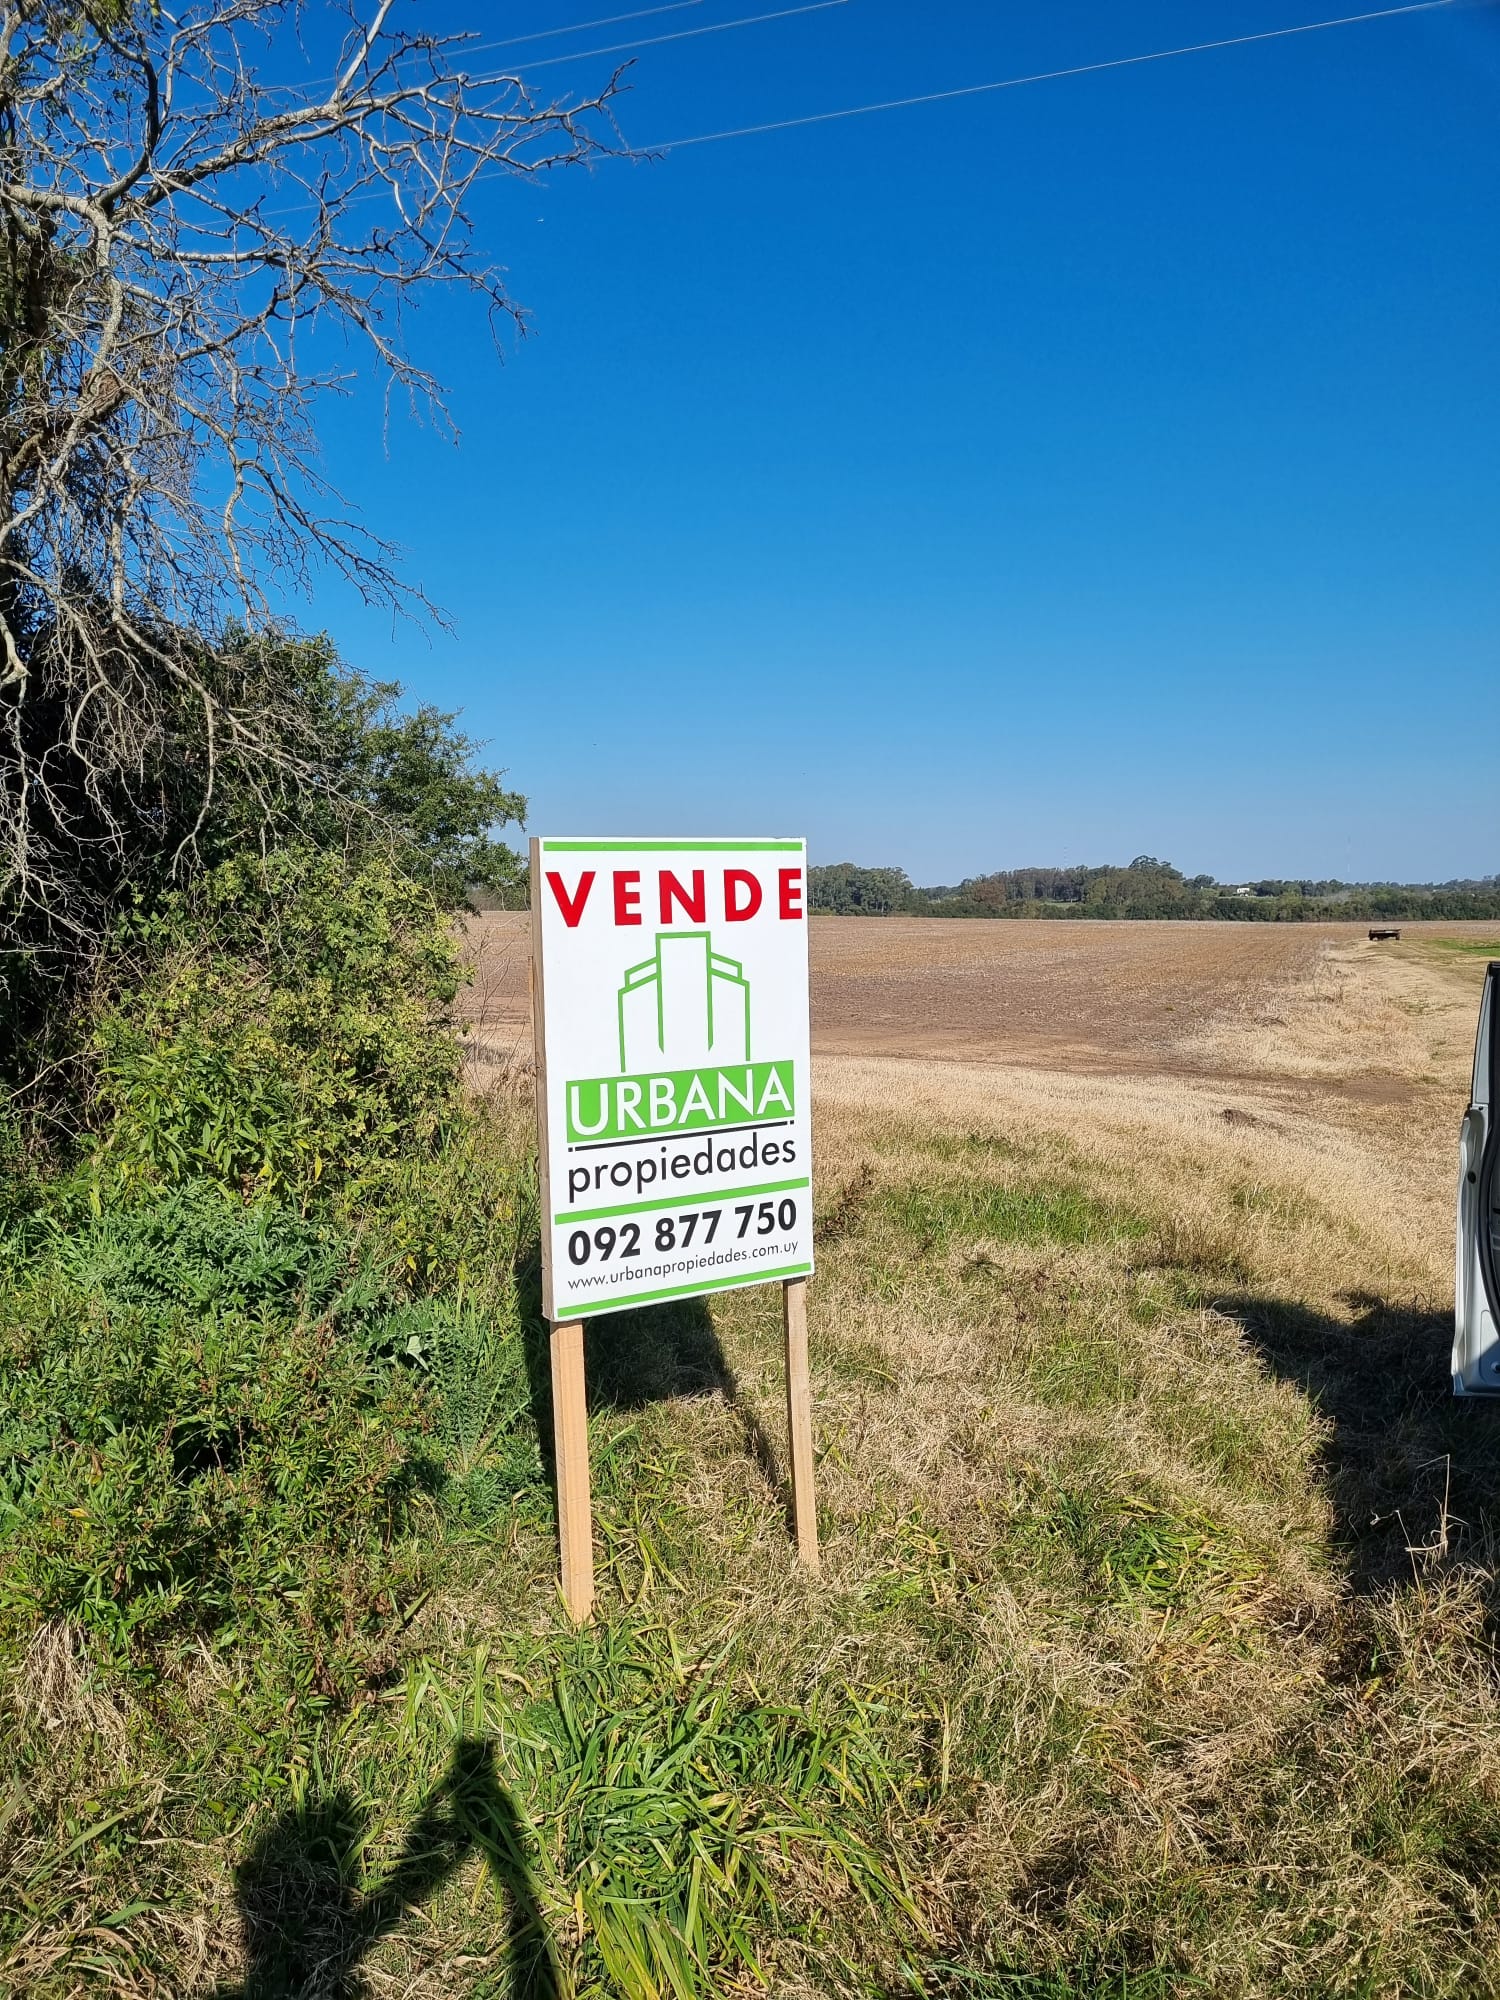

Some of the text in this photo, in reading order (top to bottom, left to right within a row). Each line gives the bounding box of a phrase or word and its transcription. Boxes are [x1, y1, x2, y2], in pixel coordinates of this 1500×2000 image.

[545, 868, 802, 927] VENDE
[570, 1065, 793, 1136] URBANA
[568, 1131, 796, 1203] propiedades
[567, 1239, 799, 1289] www.urbanapropiedades.com.uy
[568, 1198, 797, 1266] 092 877 750
